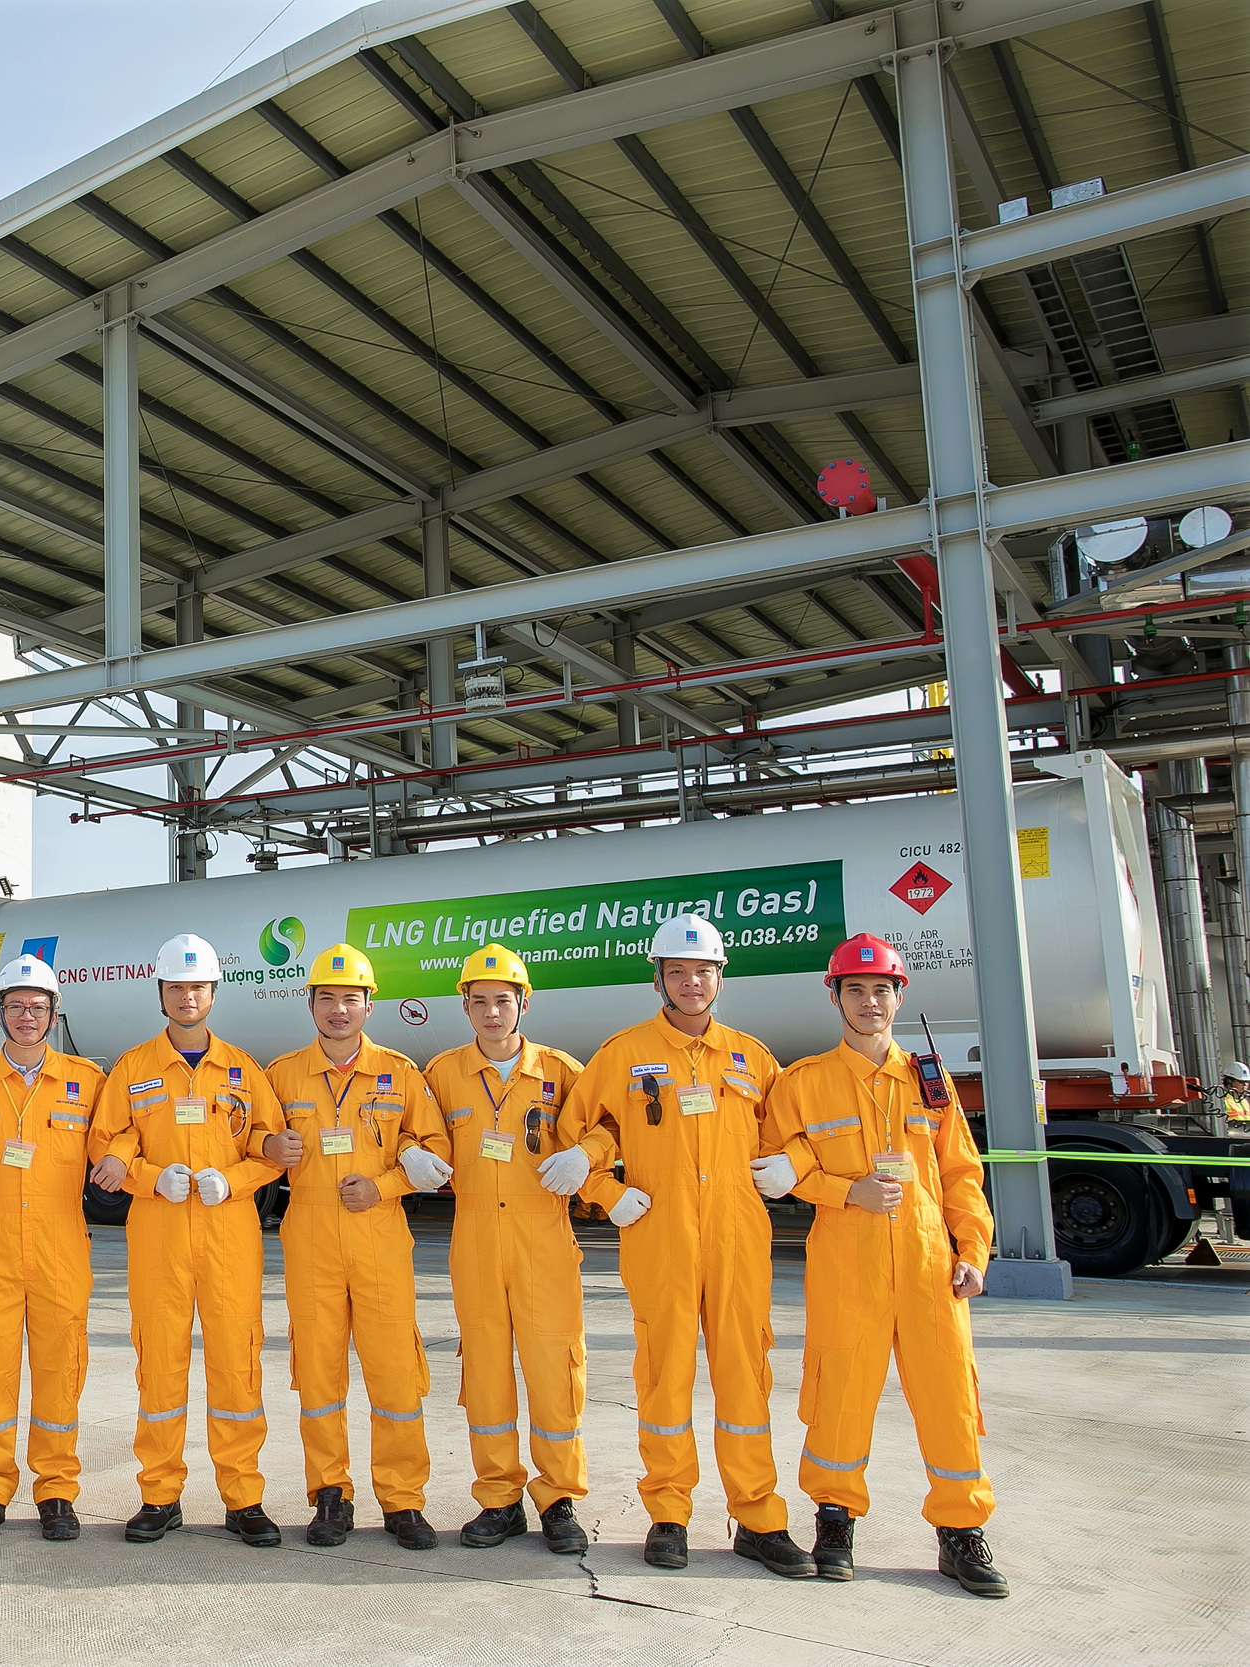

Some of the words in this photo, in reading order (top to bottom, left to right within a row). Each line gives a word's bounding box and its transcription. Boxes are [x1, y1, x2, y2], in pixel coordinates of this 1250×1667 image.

[900, 844, 931, 858] CICU
[938, 842, 963, 854] 482
[908, 887, 933, 899] 1972
[365, 919, 425, 949] LNG
[432, 903, 588, 947] (Liquefied
[596, 890, 725, 930] Natural
[736, 879, 818, 918] Gas)
[615, 939, 651, 957] hotl
[719, 923, 819, 948] 3.038.498
[884, 932, 903, 942] RID
[920, 929, 939, 940] ADR
[913, 939, 944, 951] CFR49
[905, 949, 954, 961] PORTABLE
[959, 948, 973, 958] TA
[909, 960, 943, 971] IMPACT
[949, 958, 974, 969] APPR
[58, 967, 88, 984] CNG
[222, 968, 264, 986] lượng
[268, 963, 306, 983] sạch
[253, 988, 267, 1000] tới
[269, 987, 289, 1001] mọi
